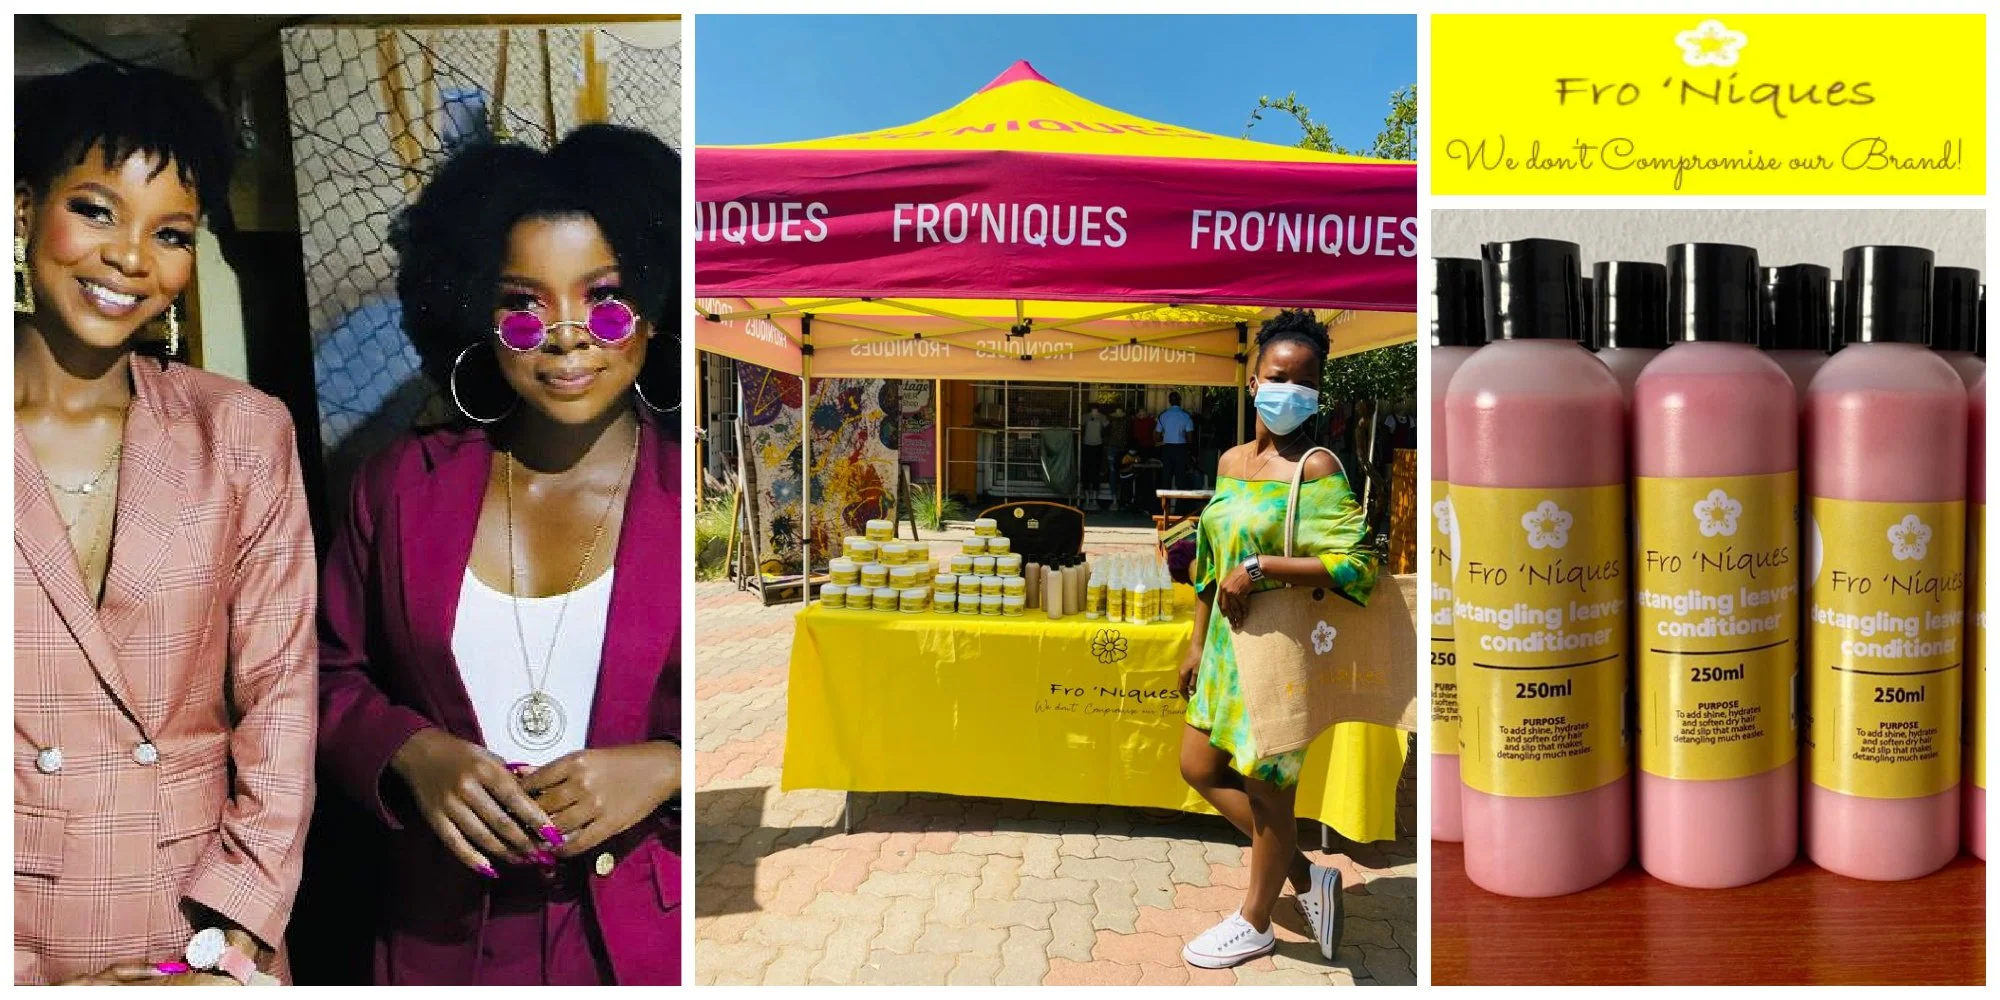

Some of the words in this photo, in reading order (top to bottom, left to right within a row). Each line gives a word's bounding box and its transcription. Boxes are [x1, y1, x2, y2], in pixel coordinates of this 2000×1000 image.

[893, 202, 1128, 248] FRO'NIQUES
[1190, 209, 1417, 258] FRO'NIQUES
[1647, 551, 1682, 573] Fro
[1469, 562, 1507, 586] Fro
[1832, 571, 1871, 594] Fro
[1639, 588, 1734, 615] etangling
[1657, 613, 1782, 638] conditioner
[1480, 626, 1613, 653] conditioner
[1841, 637, 1957, 659] conditioner
[1431, 652, 1456, 666] 250
[1690, 663, 1745, 683] 250ml
[1050, 684, 1085, 697] Fro
[1515, 679, 1573, 699] 250ml
[1874, 685, 1926, 703] 250ml
[1698, 700, 1740, 710] PURPOSE
[1523, 716, 1566, 726] PURPOSE
[1676, 710, 1685, 718] To
[1686, 710, 1702, 719] add
[1500, 726, 1509, 735] To
[1510, 726, 1526, 735] add
[1555, 722, 1589, 735] hydrates
[1682, 718, 1697, 727] and
[1699, 717, 1725, 727] soften
[1726, 717, 1740, 727] dry
[1880, 722, 1919, 730] PURPOSE
[1506, 734, 1522, 743] and
[1523, 733, 1550, 743] soften
[1552, 732, 1566, 743] dry
[1568, 730, 1583, 740] hair
[1681, 727, 1696, 735] and
[1697, 726, 1711, 736] slip
[1713, 726, 1729, 735] that
[1856, 728, 1865, 737] To
[1867, 729, 1882, 737] add
[1718, 734, 1741, 743] much
[1863, 737, 1878, 745] and
[1880, 737, 1904, 746] soften
[1906, 737, 1918, 747] dry
[1504, 742, 1519, 751] and
[1521, 742, 1536, 753] slip
[1538, 741, 1555, 751] that
[1877, 745, 1891, 755] slip
[1893, 745, 1908, 754] that
[1497, 750, 1540, 761] detangling
[1543, 749, 1567, 759] much
[1853, 752, 1895, 763] detangling
[1897, 752, 1918, 761] much
